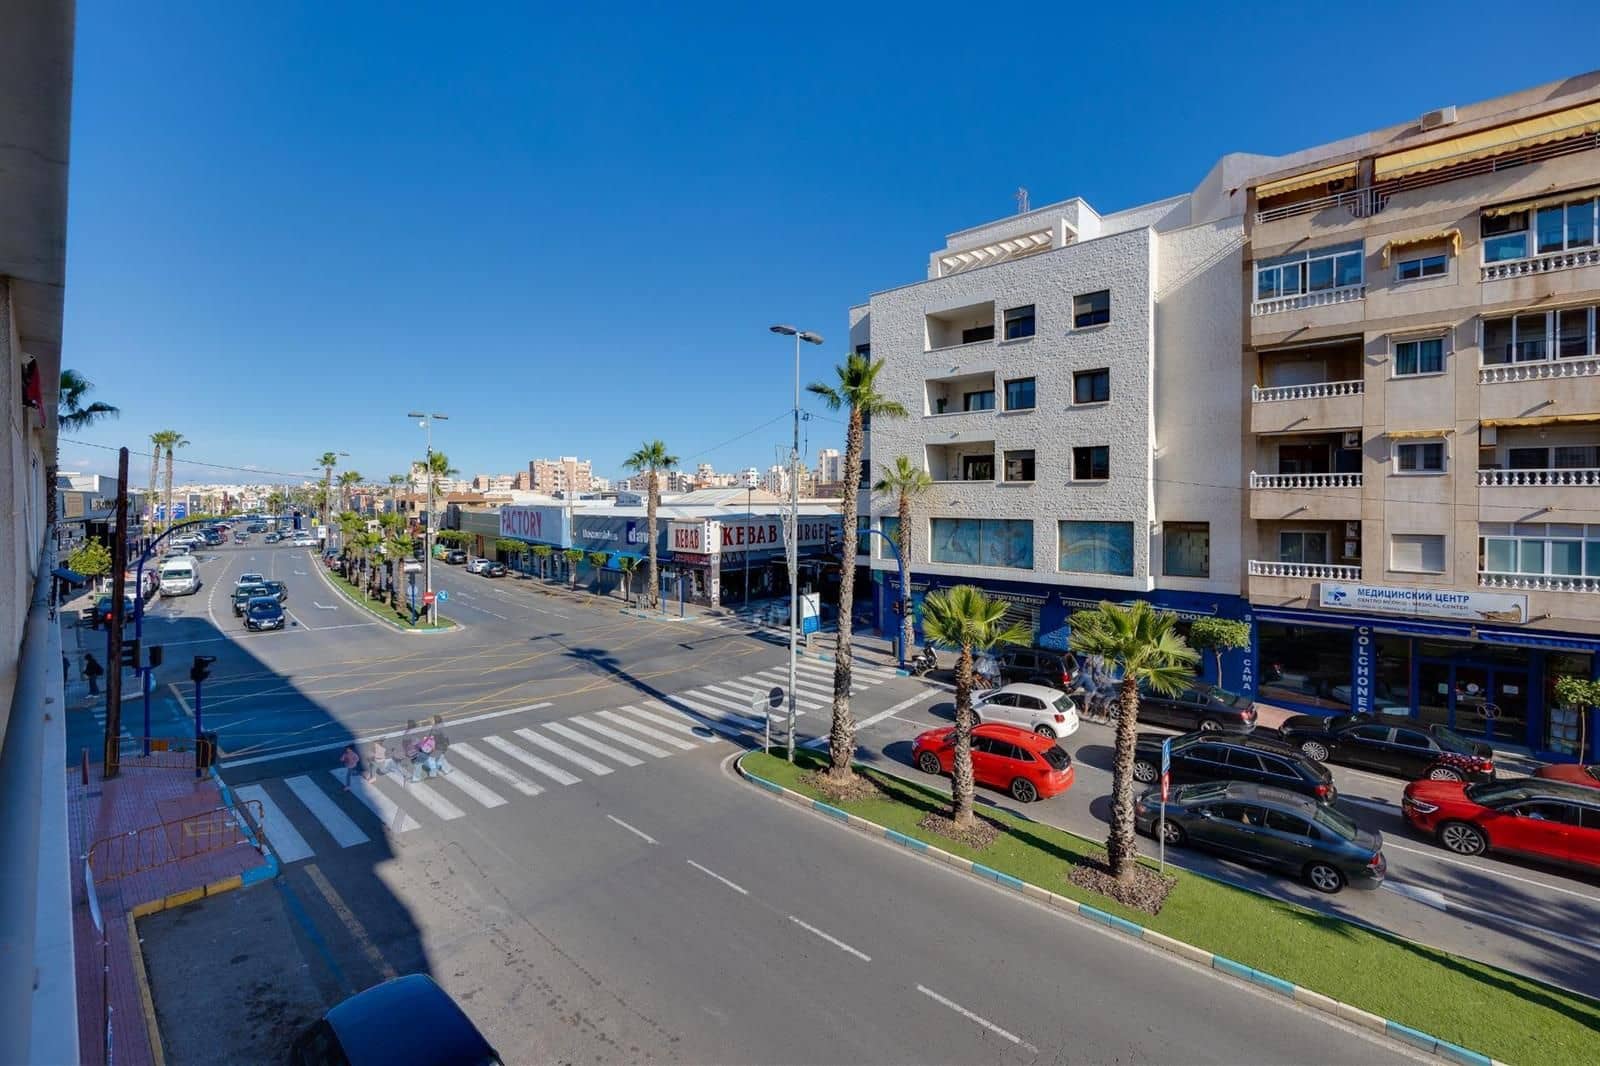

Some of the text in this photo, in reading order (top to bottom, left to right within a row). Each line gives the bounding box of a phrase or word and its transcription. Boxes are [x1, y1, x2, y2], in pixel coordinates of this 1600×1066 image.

[502, 510, 542, 537] FACTORY
[675, 528, 700, 549] KEBAB
[722, 525, 777, 545] KEBAB
[1358, 588, 1470, 603] МЕДИЦИНСКИЙ ЦЕНТР
[1242, 659, 1252, 690] CAMA
